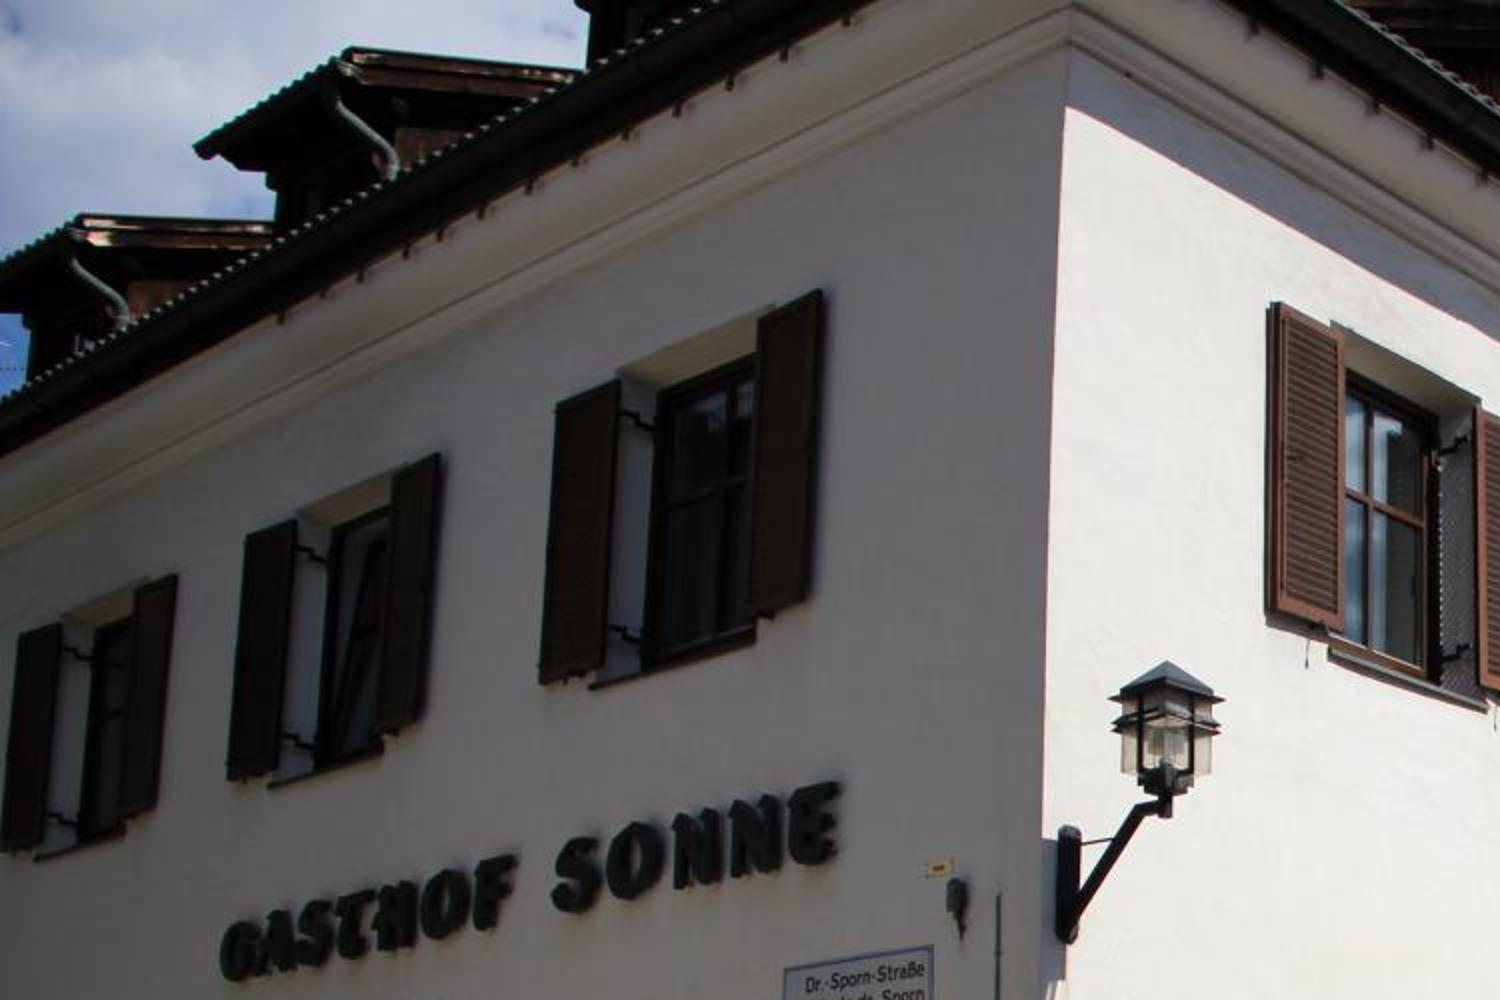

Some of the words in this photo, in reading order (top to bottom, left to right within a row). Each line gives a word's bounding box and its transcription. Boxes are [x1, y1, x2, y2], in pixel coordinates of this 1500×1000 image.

[219, 854, 518, 981] GASTHOF
[550, 780, 841, 914] SONNE
[805, 961, 925, 994] Dr.-Sporn-Straße
